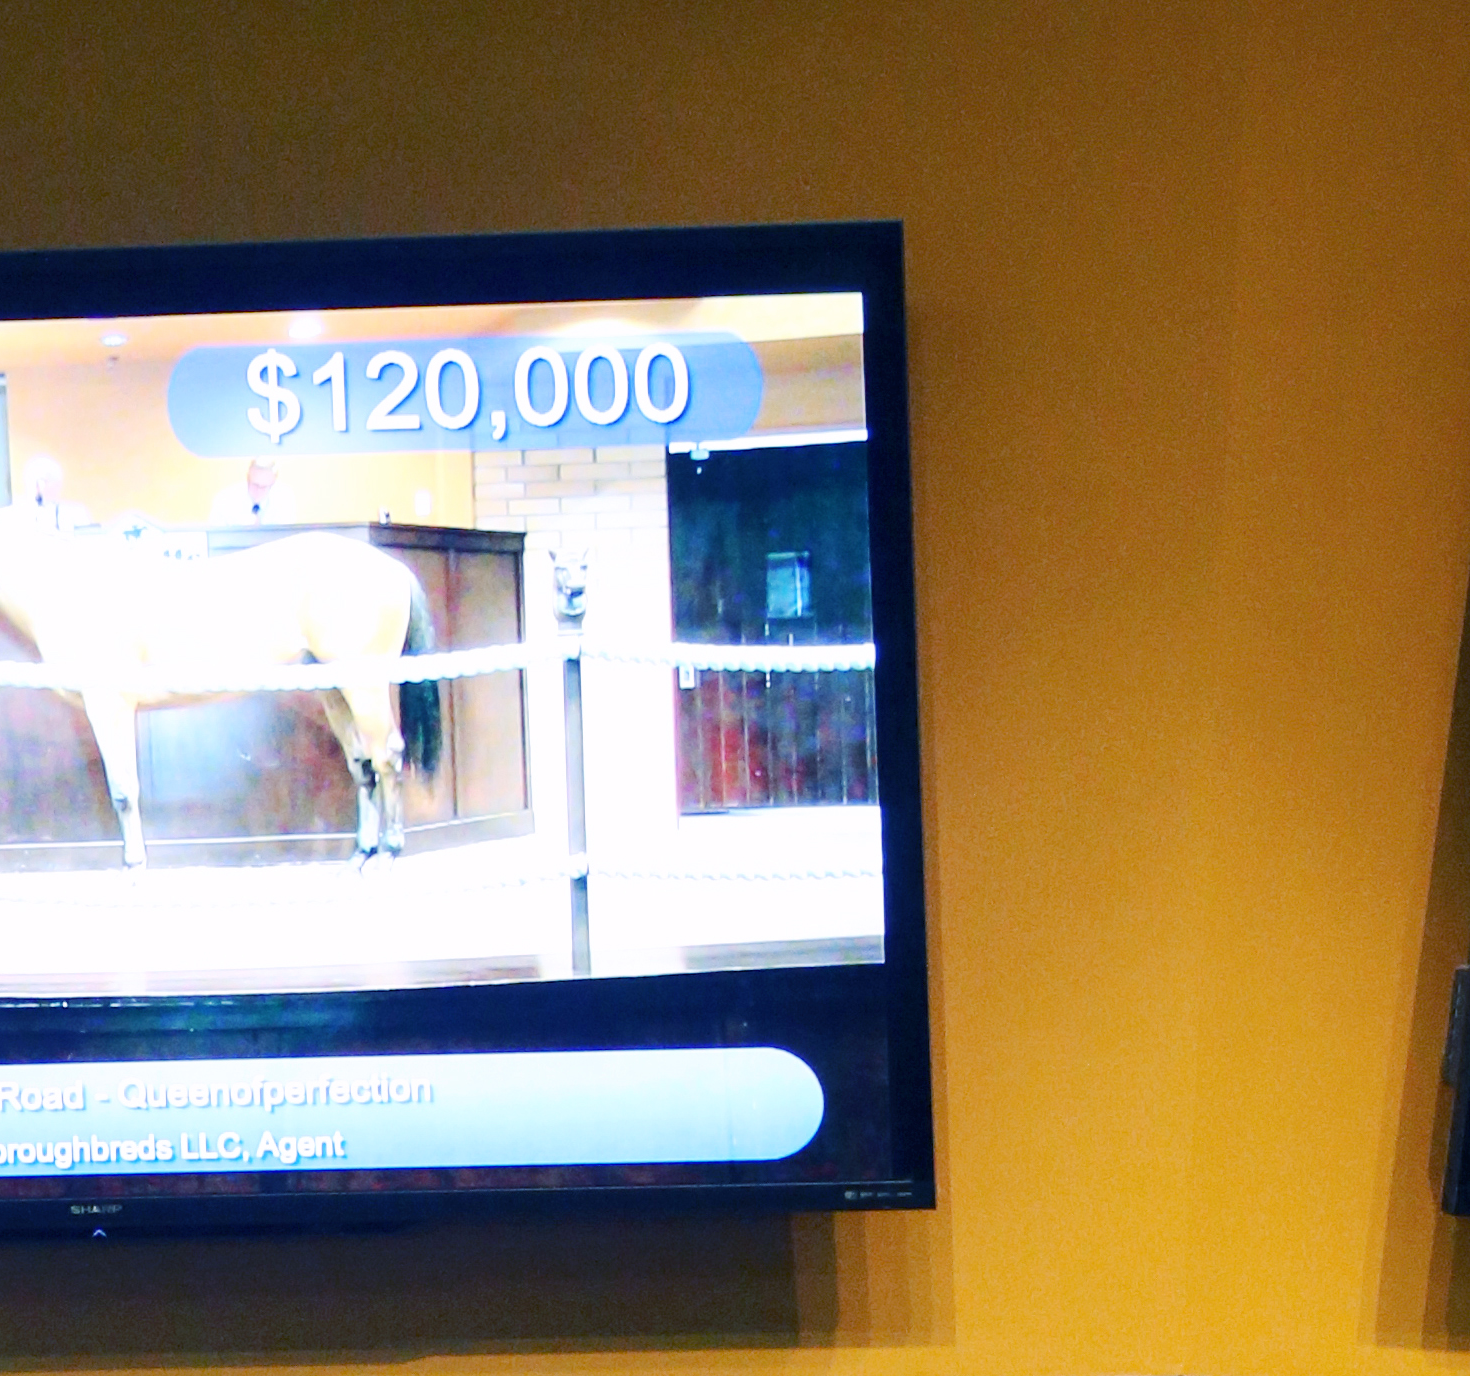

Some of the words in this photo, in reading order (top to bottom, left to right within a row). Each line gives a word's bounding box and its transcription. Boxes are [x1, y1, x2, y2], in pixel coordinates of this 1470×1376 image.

[245, 341, 691, 444] $120,000
[117, 1073, 434, 1114] Queenofperfection
[180, 1131, 251, 1163] LLC,
[256, 1130, 348, 1164] Agent
[70, 1204, 124, 1215] SHARP
